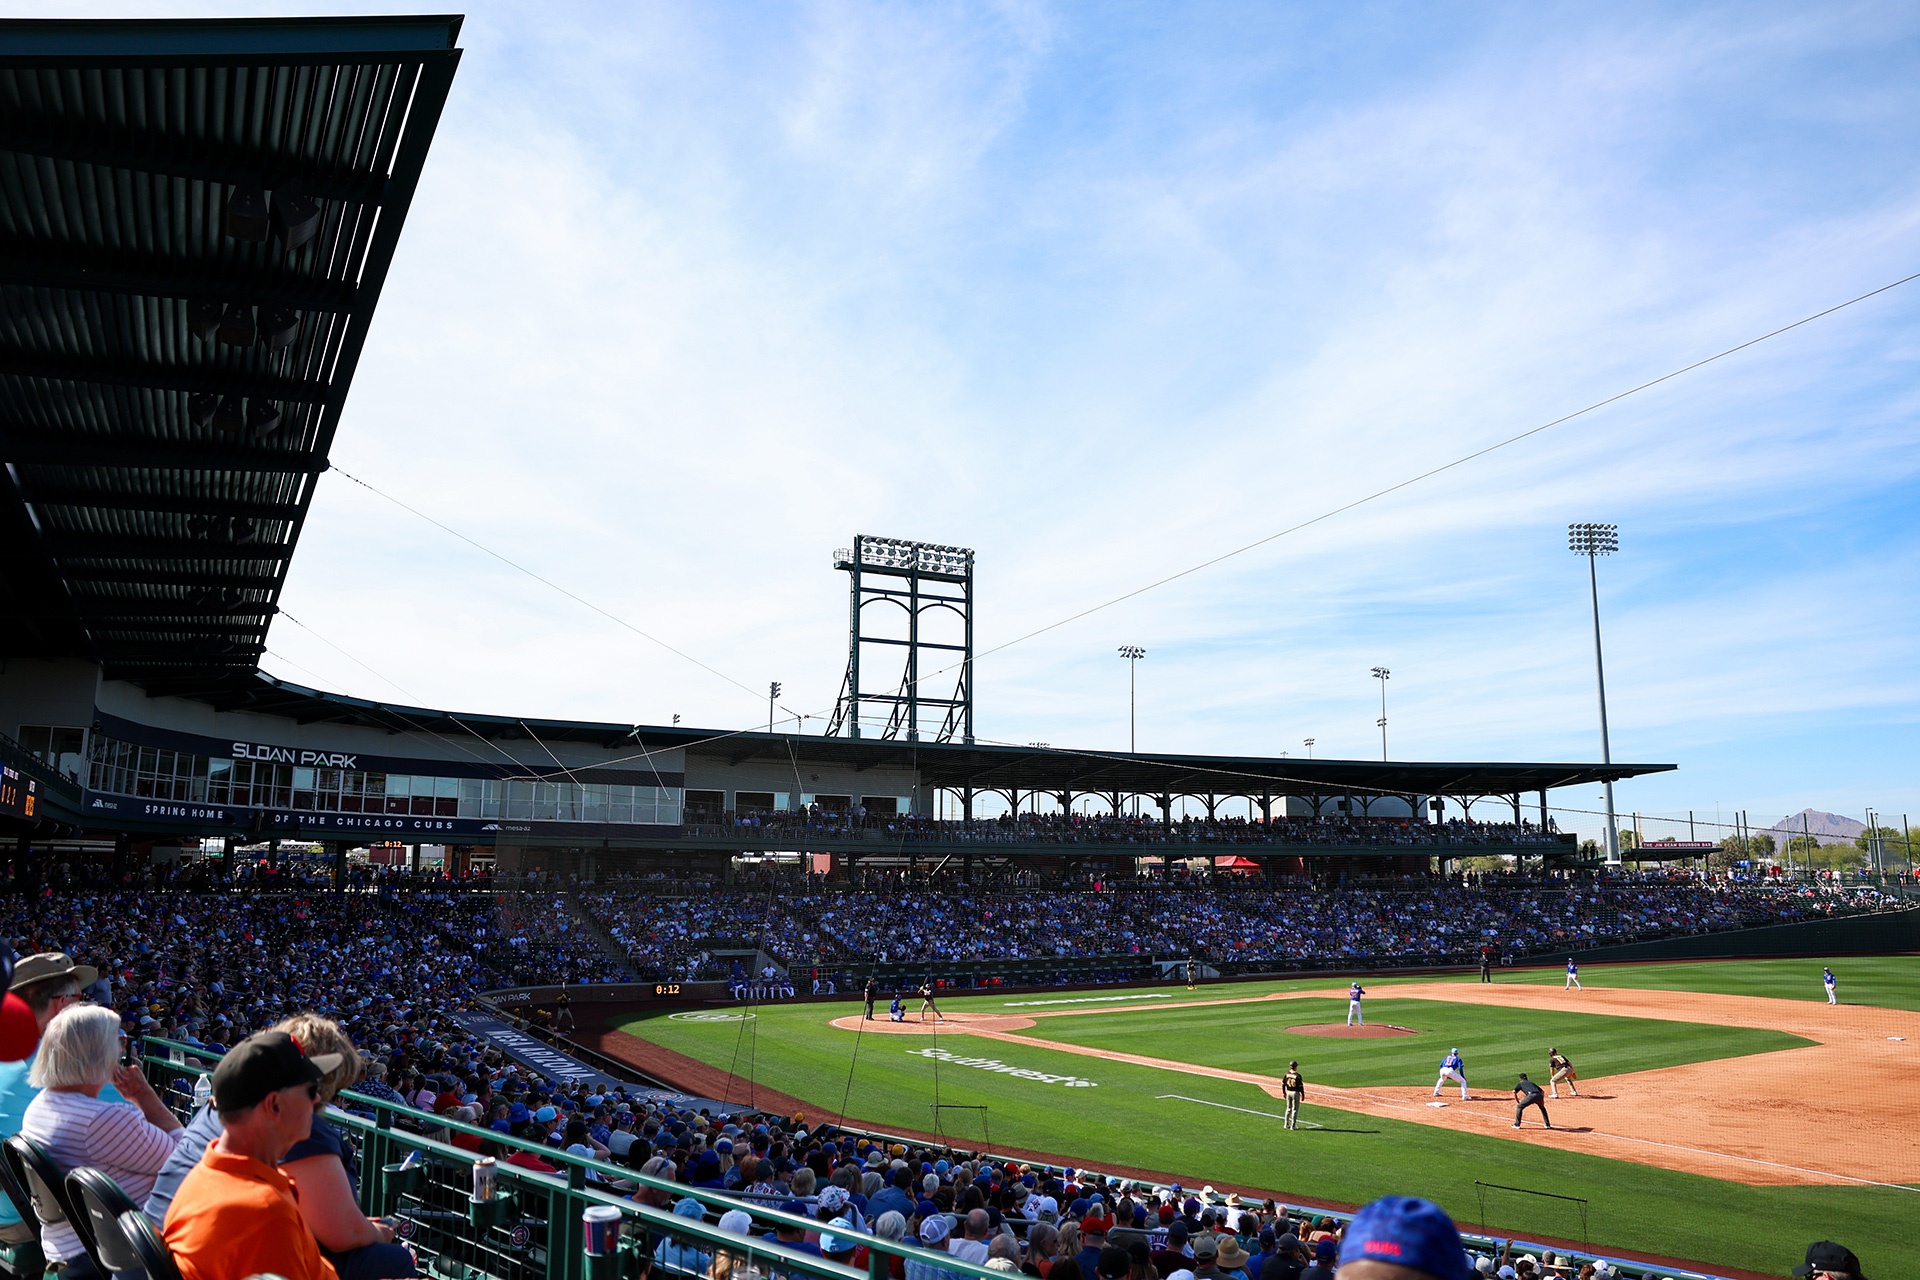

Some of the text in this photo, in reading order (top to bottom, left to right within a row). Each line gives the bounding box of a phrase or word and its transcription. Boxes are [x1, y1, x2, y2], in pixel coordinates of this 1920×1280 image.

[232, 742, 357, 769] SLOAN PARK
[145, 804, 224, 819] SPRING HOME
[275, 814, 453, 830] OF THE CHICAGO CUBS
[384, 840, 402, 848] 0:12
[508, 992, 531, 1001] PARK
[656, 984, 680, 995] 0:12
[485, 1030, 596, 1078] MESA ARIZONA
[905, 1048, 1077, 1083] Southwest
